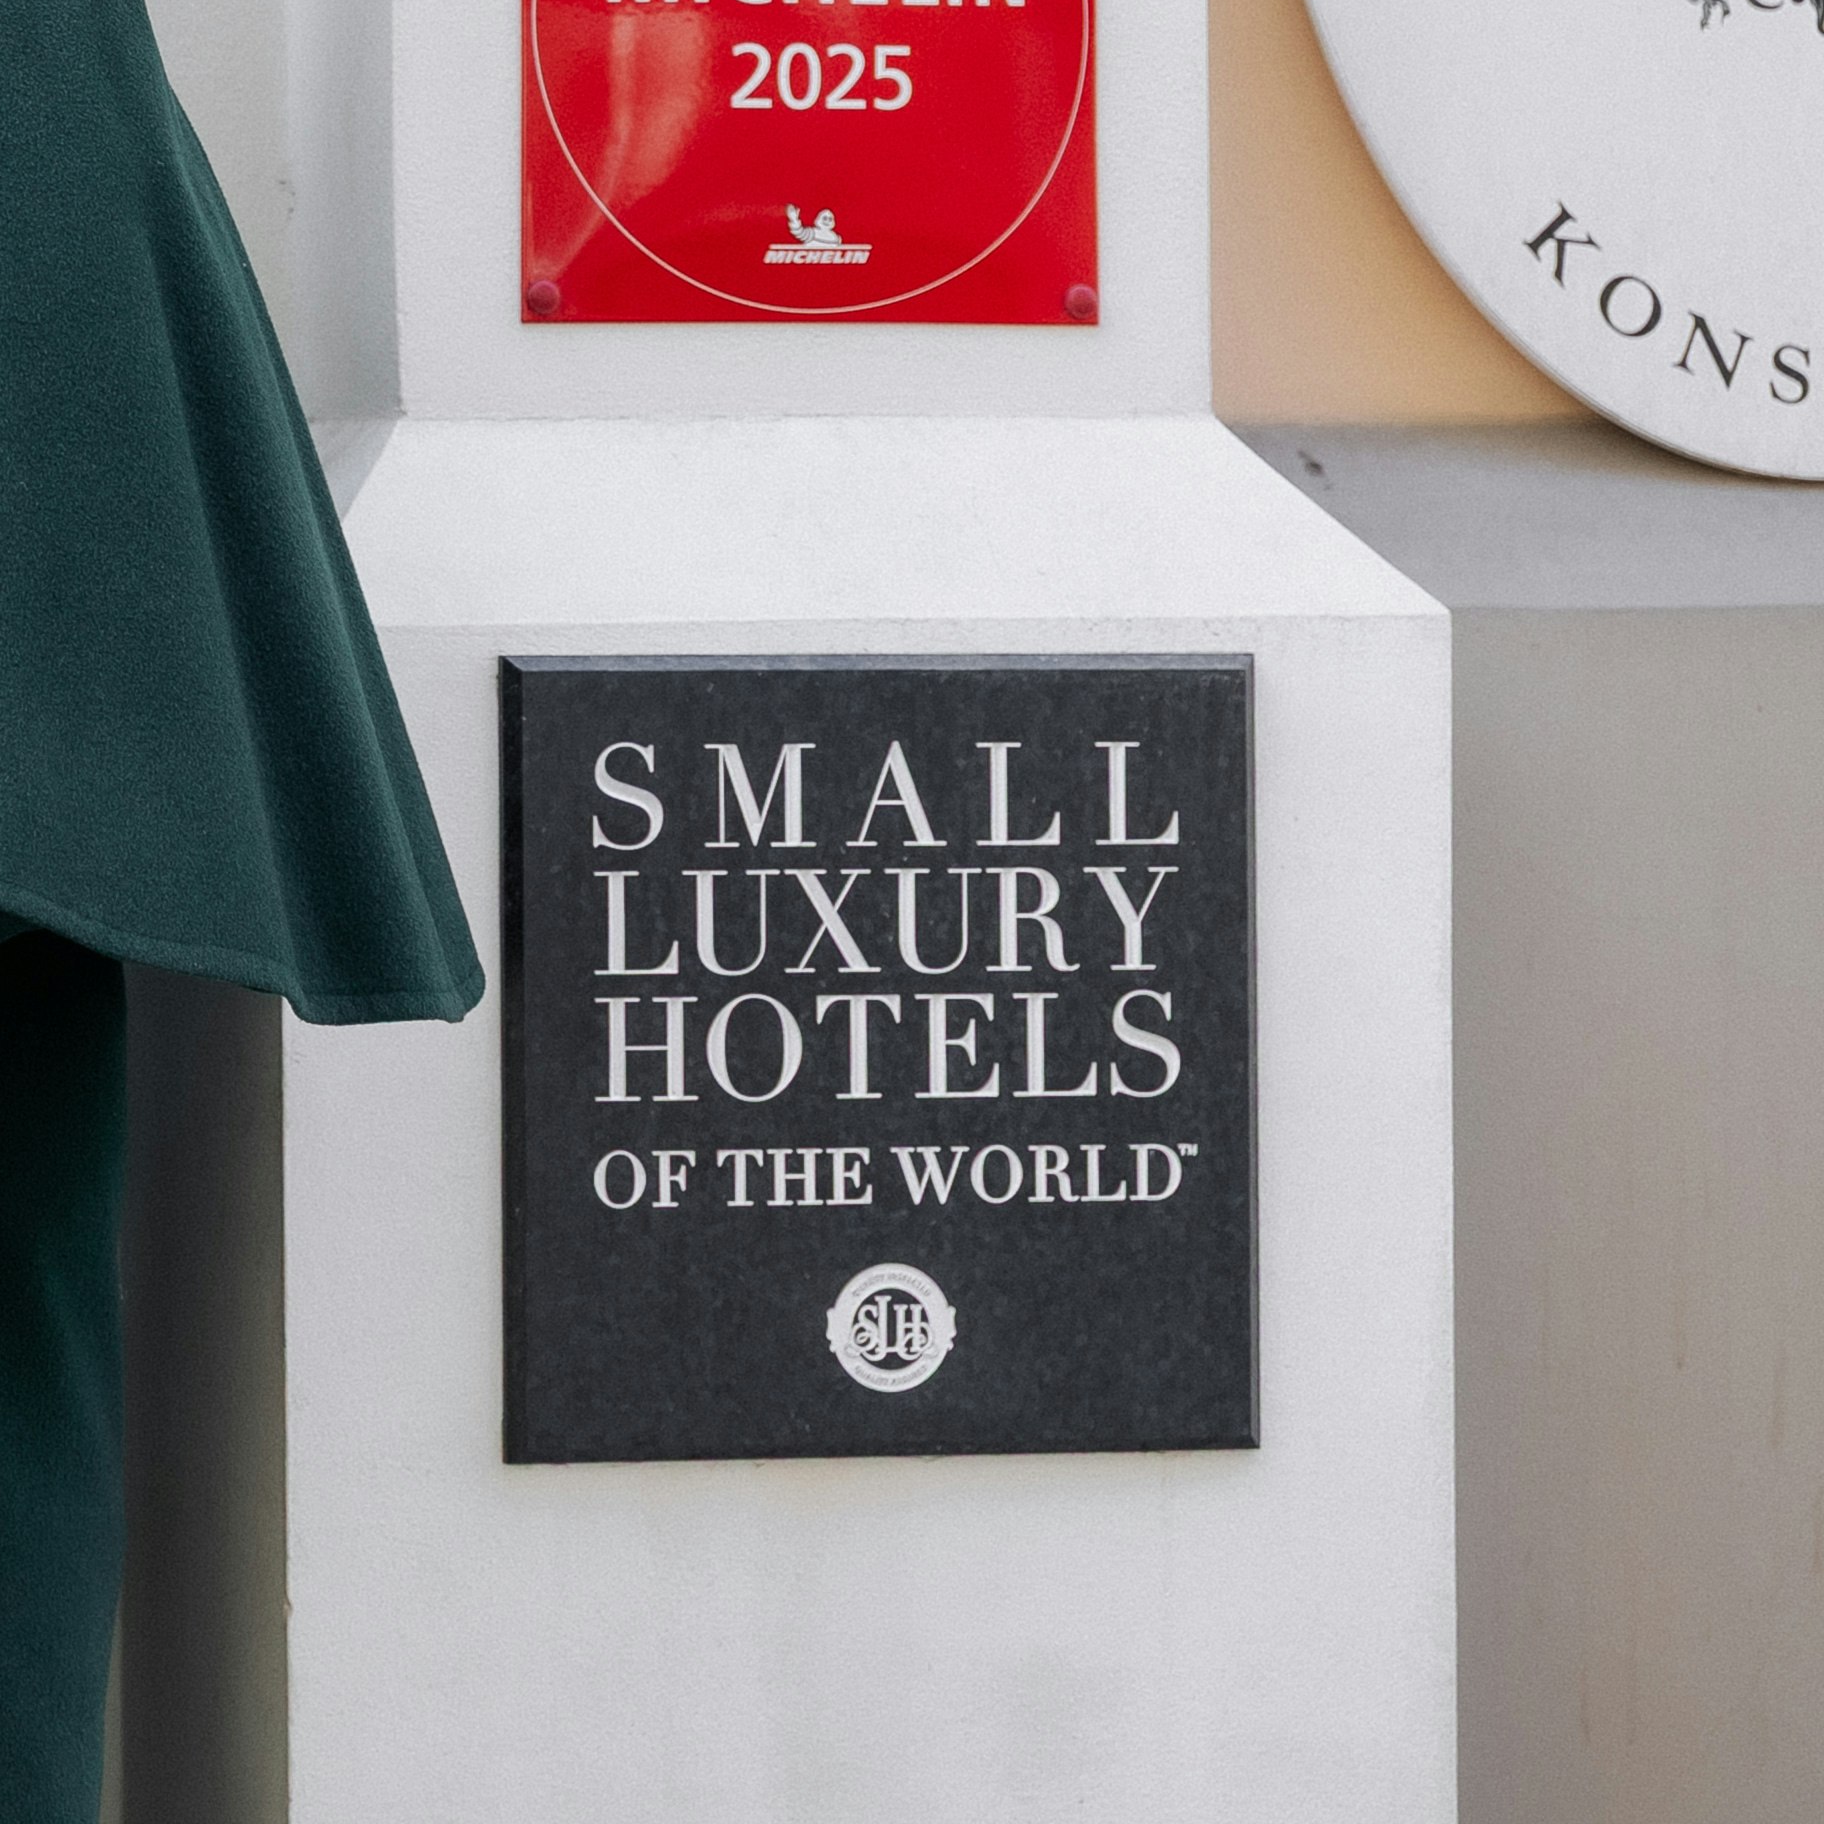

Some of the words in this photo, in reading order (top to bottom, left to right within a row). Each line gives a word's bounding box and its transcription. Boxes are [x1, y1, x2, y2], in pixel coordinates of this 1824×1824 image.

[730, 42, 913, 111] 2025
[762, 249, 871, 265] MICHELIN
[1523, 201, 1811, 405] KONS
[591, 740, 1181, 851] SMALL
[592, 865, 1180, 977] LUXURY
[593, 988, 1182, 1103] HOTELS
[592, 1149, 697, 1210] OF
[715, 1146, 874, 1207] THE
